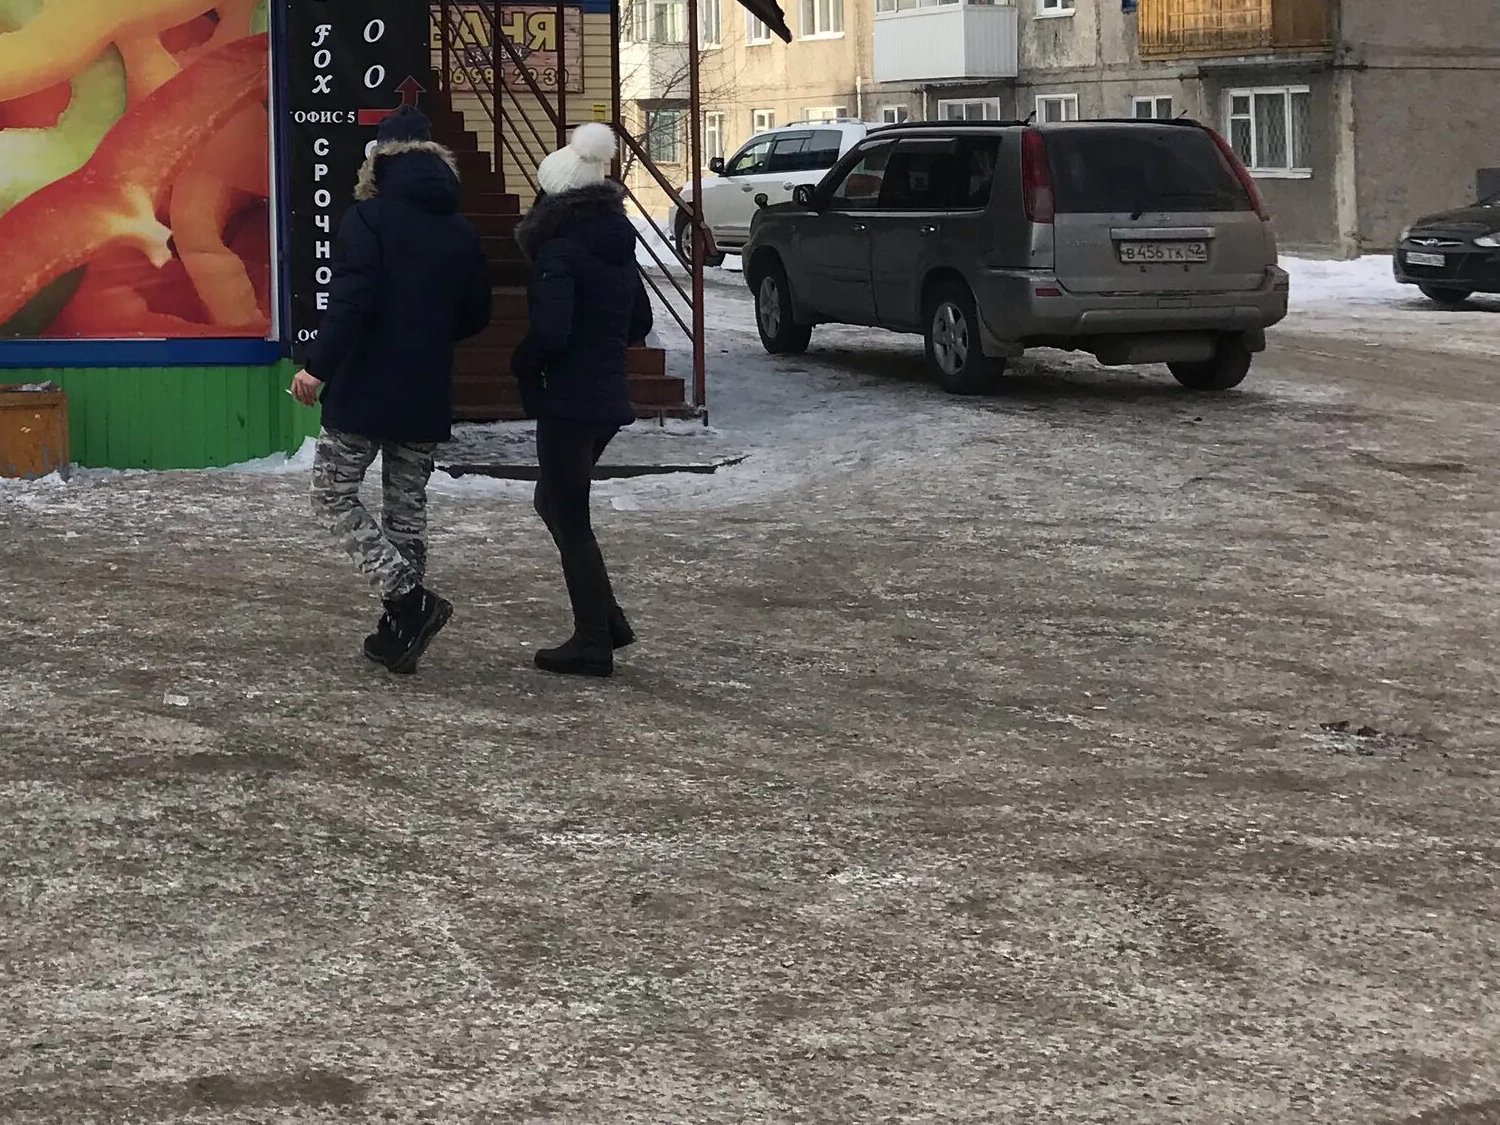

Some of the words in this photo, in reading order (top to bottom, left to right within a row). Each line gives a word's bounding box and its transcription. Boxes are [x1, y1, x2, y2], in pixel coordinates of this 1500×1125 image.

[294, 110, 343, 124] ОФИС
[347, 111, 356, 124] 5
[313, 138, 332, 310] СРОЧНОЕ
